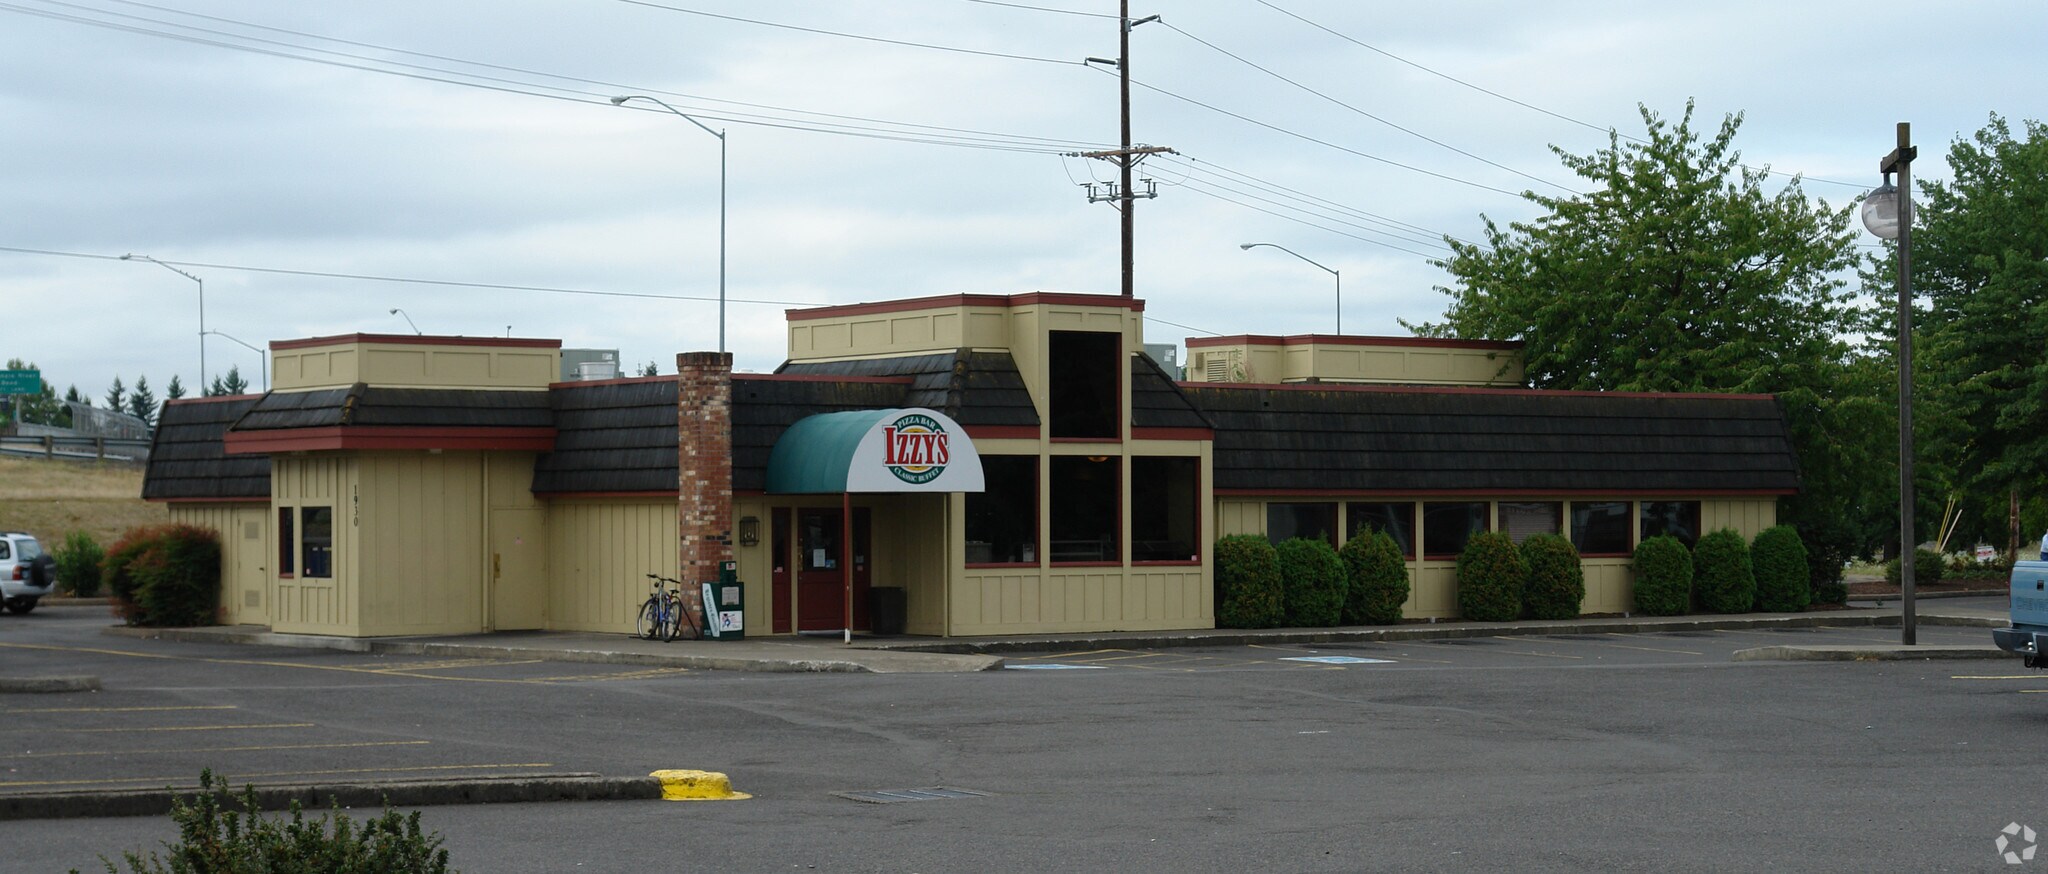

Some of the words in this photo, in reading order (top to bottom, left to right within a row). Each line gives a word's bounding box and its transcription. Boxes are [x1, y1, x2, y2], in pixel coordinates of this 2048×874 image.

[897, 415, 919, 429] PIZZA
[920, 416, 936, 430] BAR
[884, 427, 949, 465] IZZY'S
[893, 467, 917, 482] CLASSIC
[918, 467, 939, 482] BUFFET
[2016, 597, 2048, 612] CHEVR
